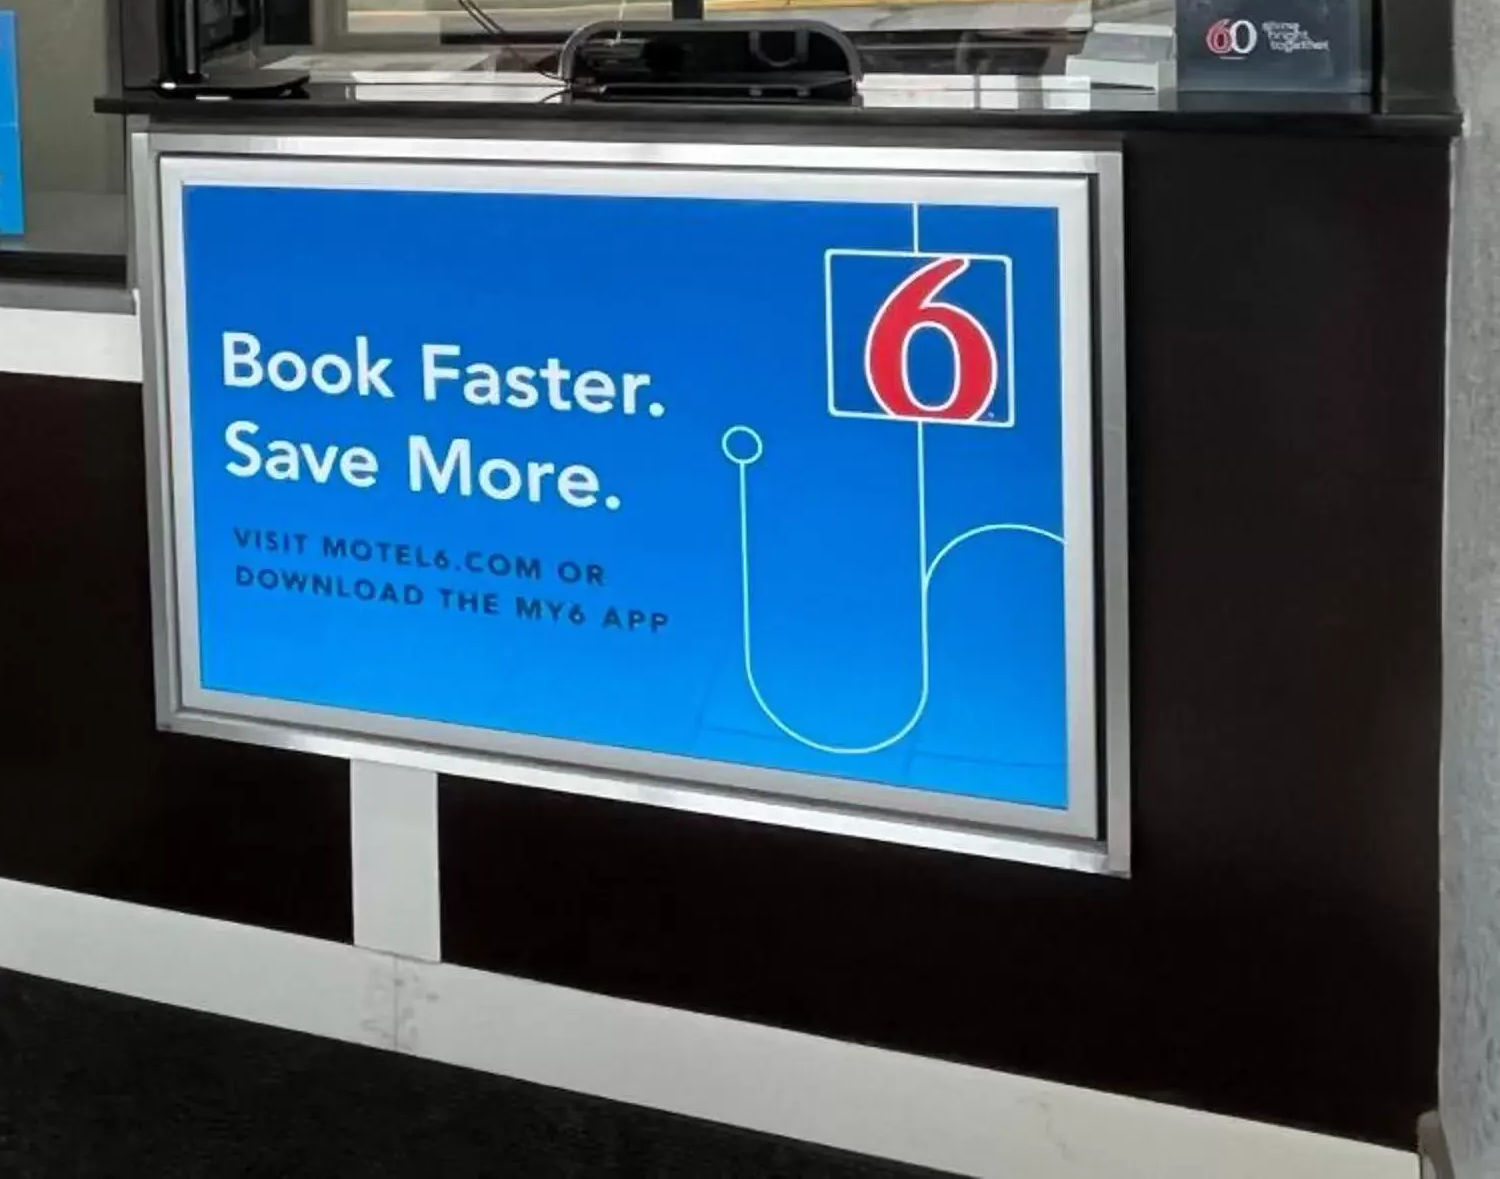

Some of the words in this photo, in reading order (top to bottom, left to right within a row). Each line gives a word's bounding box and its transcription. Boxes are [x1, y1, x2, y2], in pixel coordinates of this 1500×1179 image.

[1205, 19, 1258, 55] 60
[221, 331, 394, 400] Book
[421, 341, 667, 418] Faster.
[864, 254, 999, 423] 6
[224, 422, 380, 488] Save
[407, 434, 621, 511] More.
[233, 526, 310, 557] VISIT
[322, 534, 542, 582] MOTEL6.COM
[556, 560, 606, 587] OR
[235, 565, 425, 608] DOWNLOAD
[439, 588, 500, 617] THE
[514, 597, 588, 627] MY6
[603, 607, 671, 635] APP
